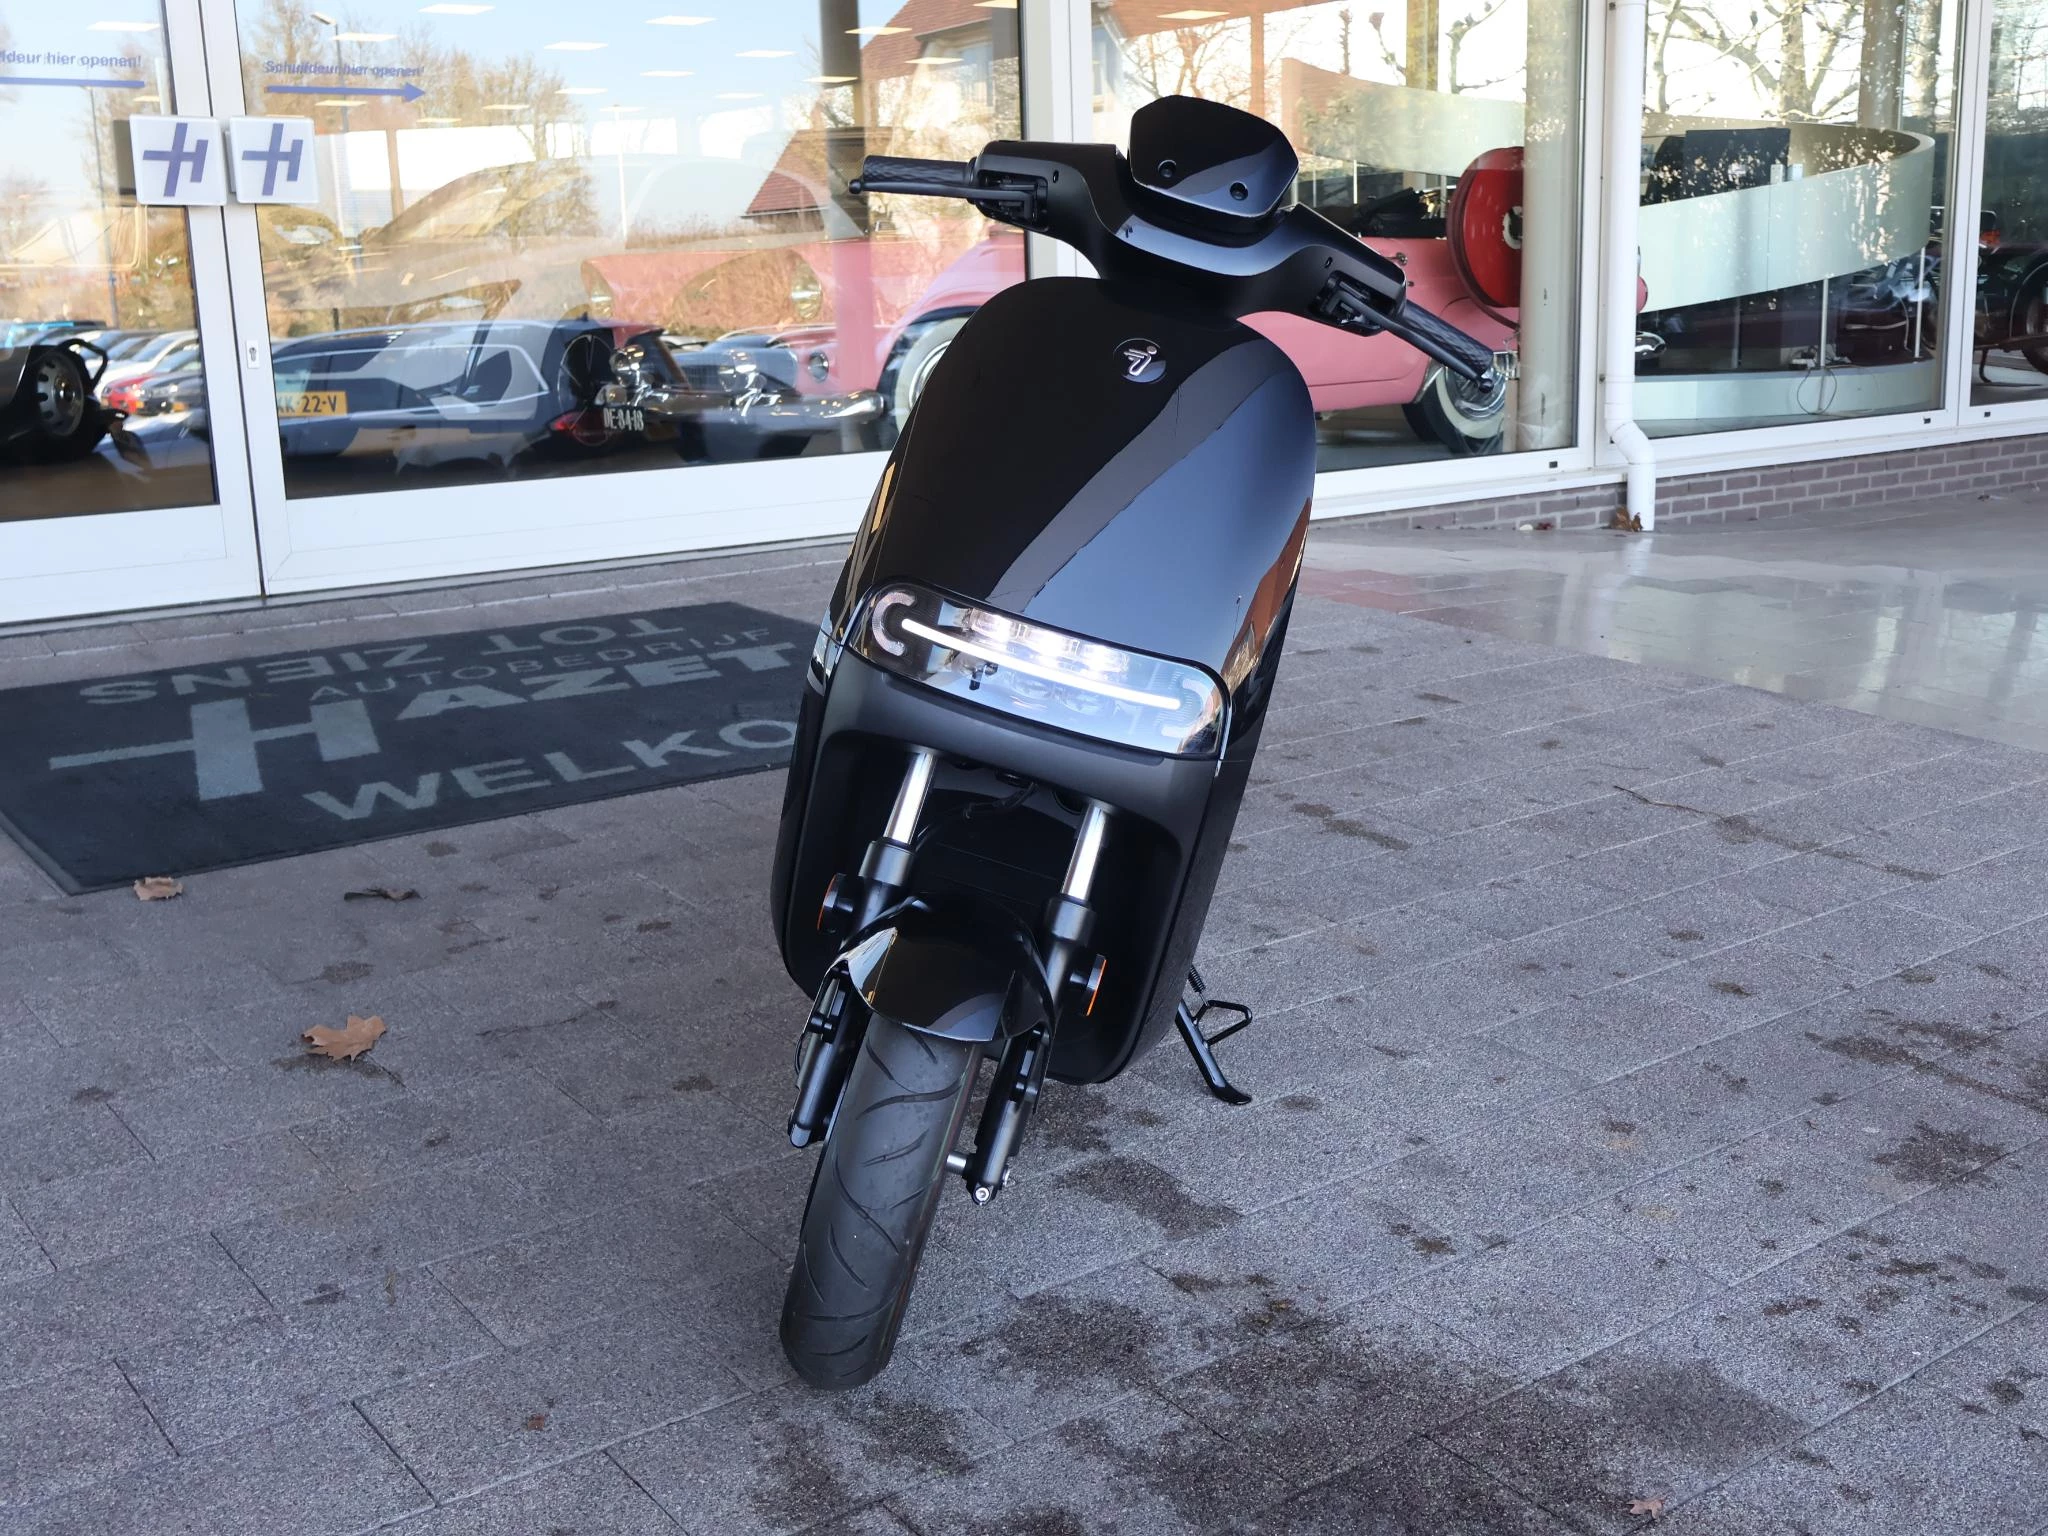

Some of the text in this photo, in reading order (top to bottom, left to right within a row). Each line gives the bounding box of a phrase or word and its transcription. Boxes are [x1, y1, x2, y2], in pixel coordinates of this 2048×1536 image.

[45, 51, 76, 65] hier
[79, 618, 684, 705] TOT ZIENS
[310, 627, 771, 701] AUTOBEDRIJF
[302, 719, 798, 821] WELKO
